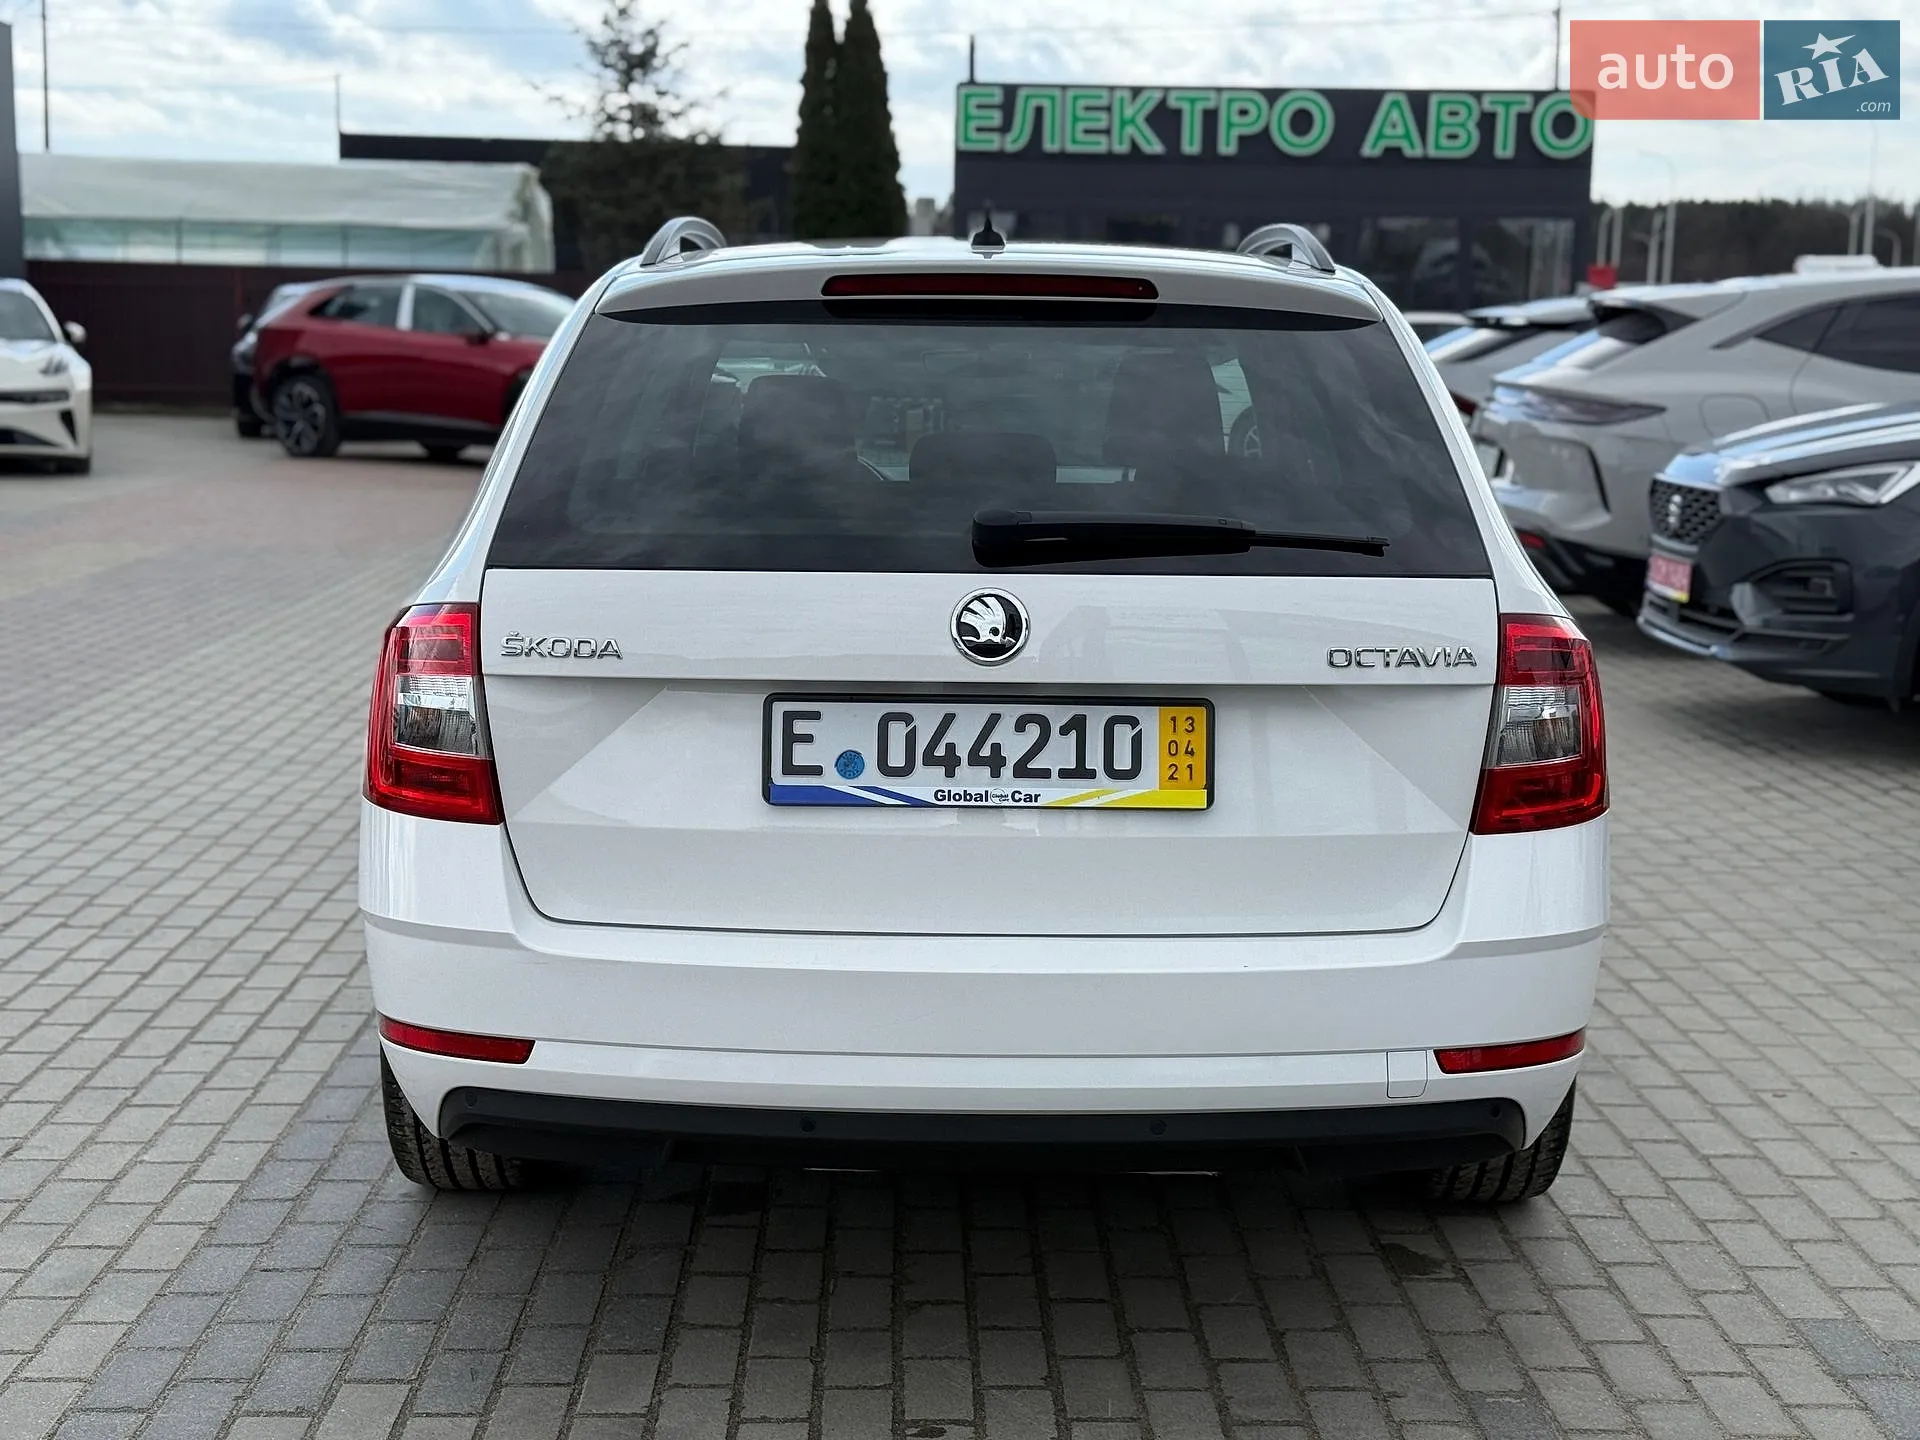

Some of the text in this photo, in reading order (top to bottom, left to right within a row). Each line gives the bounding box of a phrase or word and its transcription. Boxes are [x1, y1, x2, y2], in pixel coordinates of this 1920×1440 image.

[956, 84, 1596, 159] ЕЛЕКТРО АВТО
[500, 631, 623, 659] ŠKODA
[1327, 646, 1477, 668] OCTAVIA
[1169, 715, 1195, 733] 13
[781, 710, 824, 776] E
[876, 711, 1143, 780] 044210
[1168, 739, 1195, 756] 04
[1168, 763, 1193, 780] 21
[934, 789, 1041, 803] Global Car
